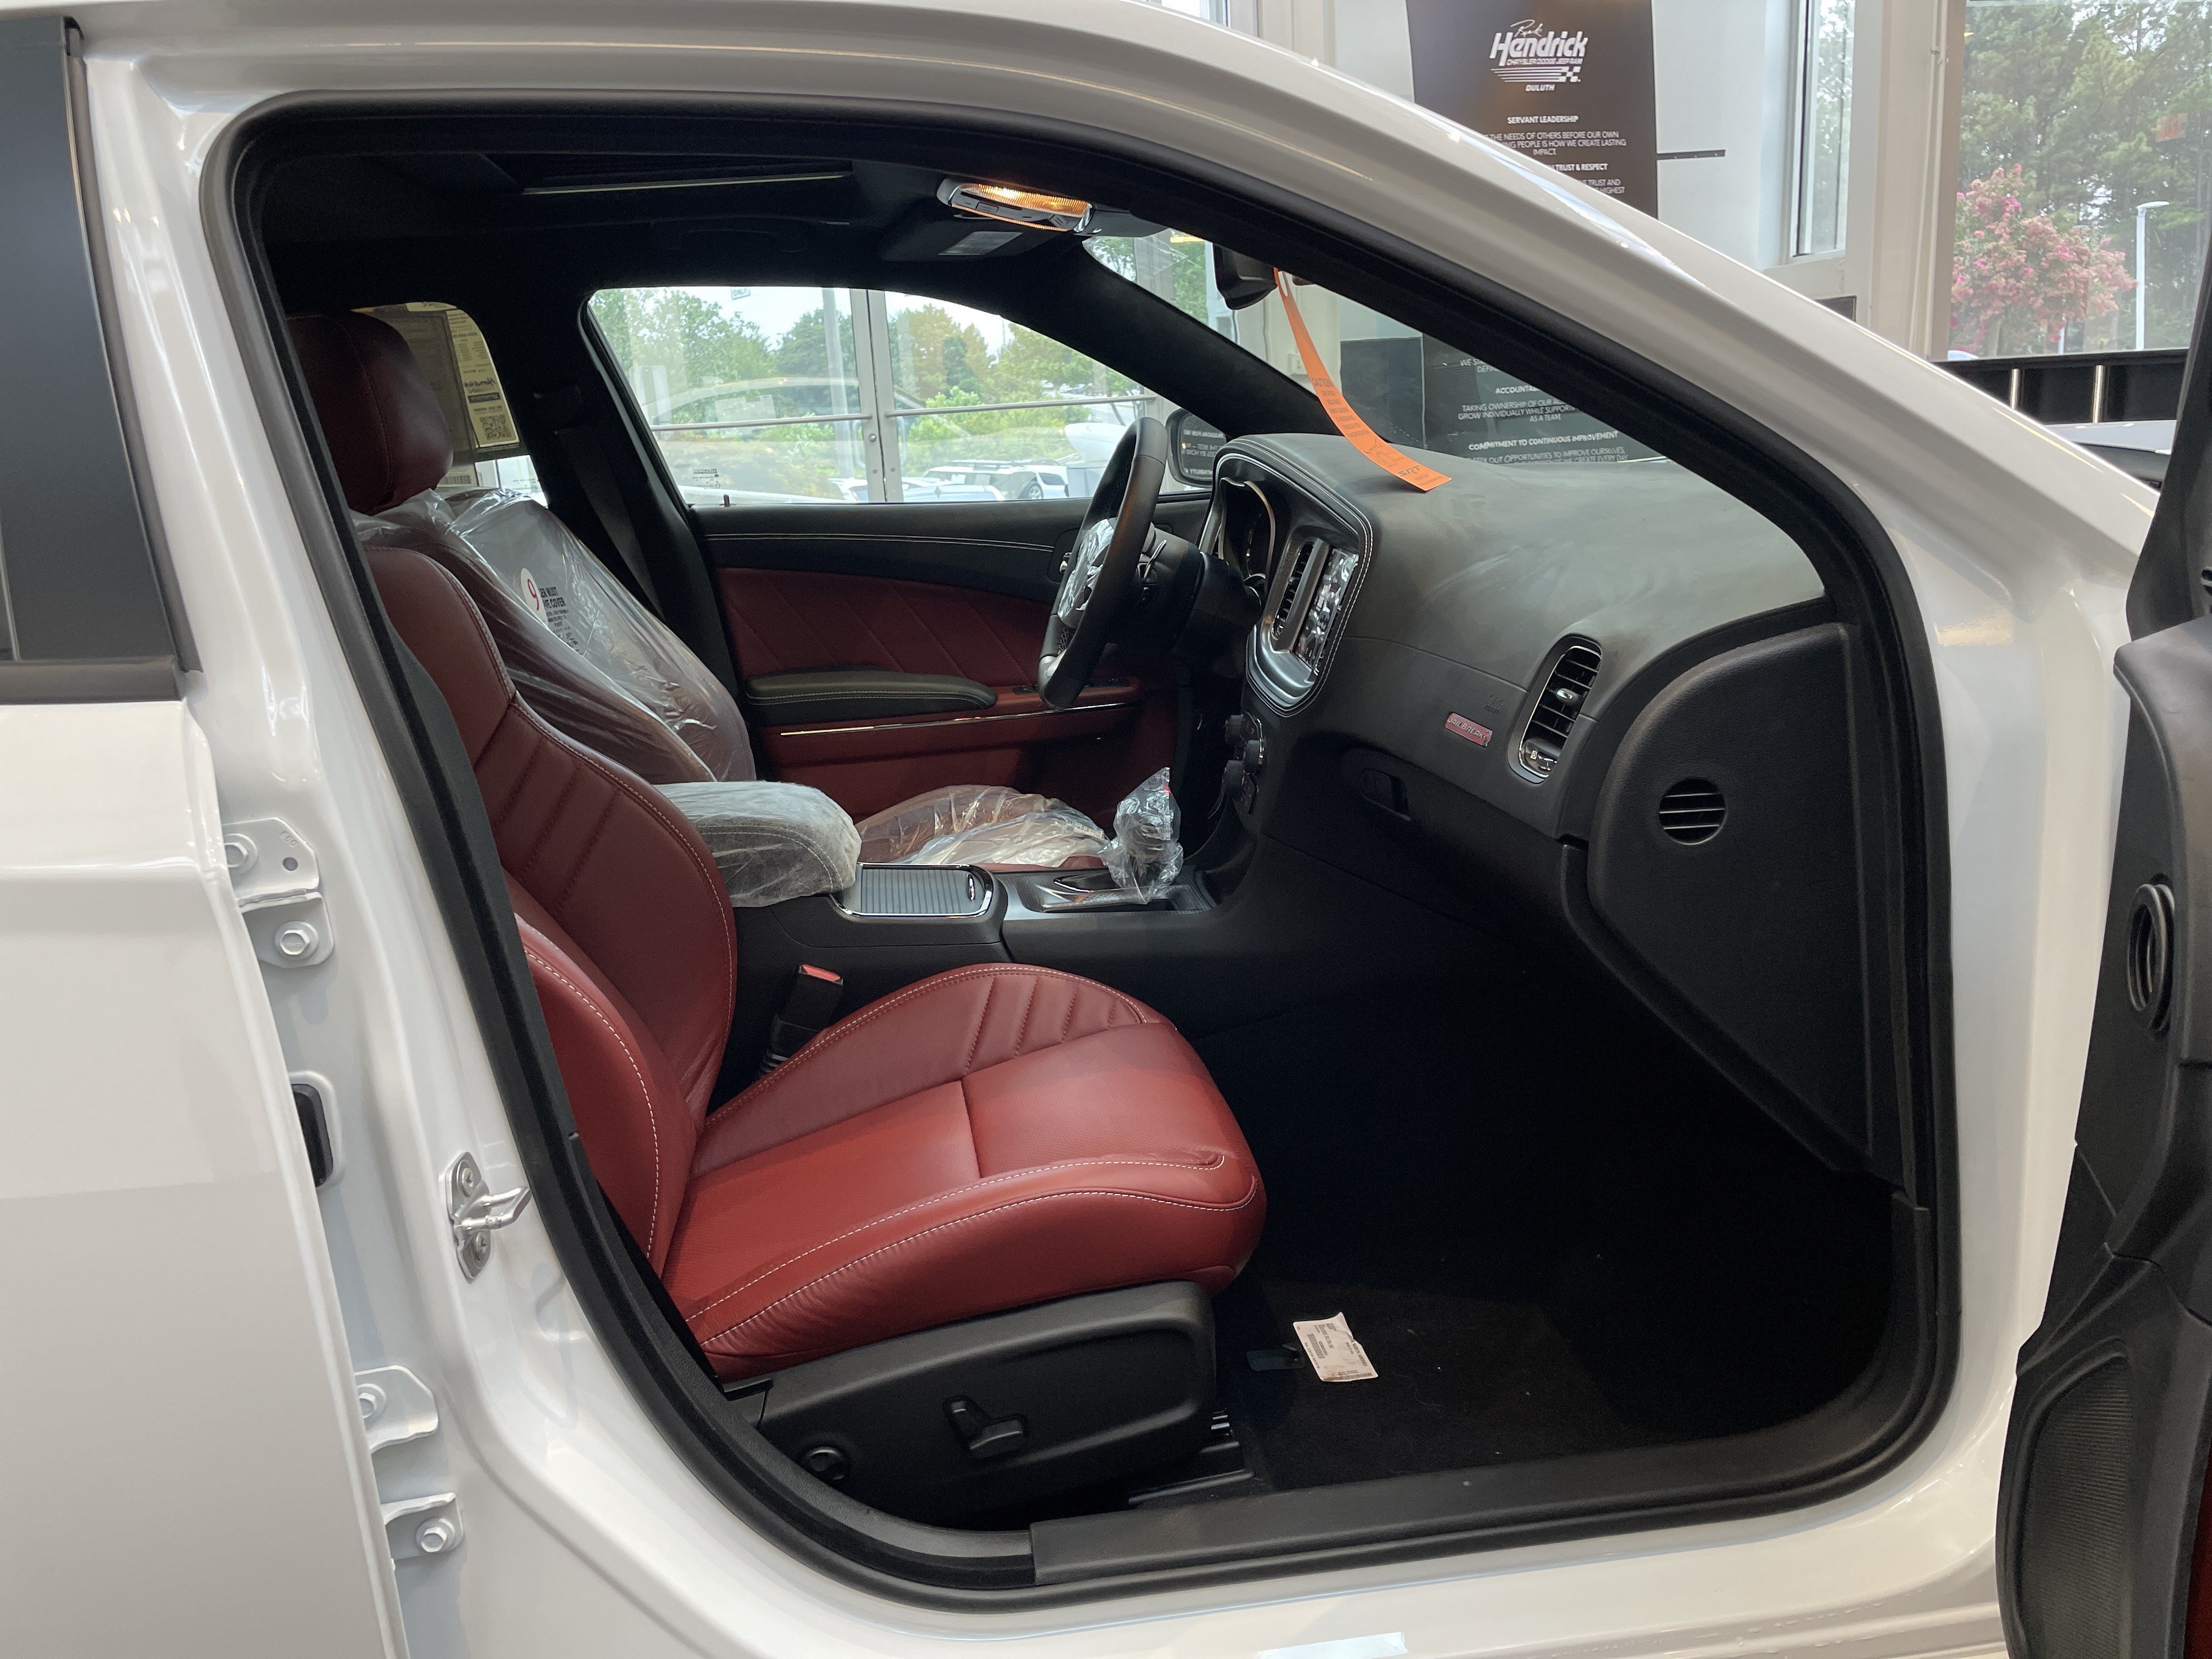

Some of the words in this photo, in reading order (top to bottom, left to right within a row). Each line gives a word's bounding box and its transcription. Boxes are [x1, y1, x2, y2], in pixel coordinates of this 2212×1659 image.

[1489, 31, 1589, 66] Hendrick
[1539, 115, 1579, 123] LEADERSHIP
[1503, 132, 1526, 140] NEEDS
[1526, 132, 1536, 140] OF
[1537, 131, 1561, 139] OTHERS
[1586, 131, 1601, 139] OUR
[1565, 139, 1577, 147] WE
[1577, 138, 1600, 146] CREATE
[1601, 138, 1627, 146] LASTING
[1462, 404, 1487, 413] TAKING
[1488, 401, 1527, 411] OWNERSHIP
[1537, 399, 1552, 407] OUR
[1458, 411, 1481, 420] GROW
[1482, 408, 1525, 418] INDIVIDUALLY
[1468, 439, 1517, 450] COMMITMENT
[1517, 438, 1528, 447] TO
[1528, 436, 1571, 445] CONTINUOUS
[1572, 430, 1618, 442] IMPROVEMENT
[1488, 456, 1503, 464] OUT
[1504, 452, 1553, 463] OPPORTUNITIES
[1563, 449, 1590, 458] IMPROVE
[1398, 465, 1420, 477] SRT
[1447, 717, 1487, 739] JAILBREAK
